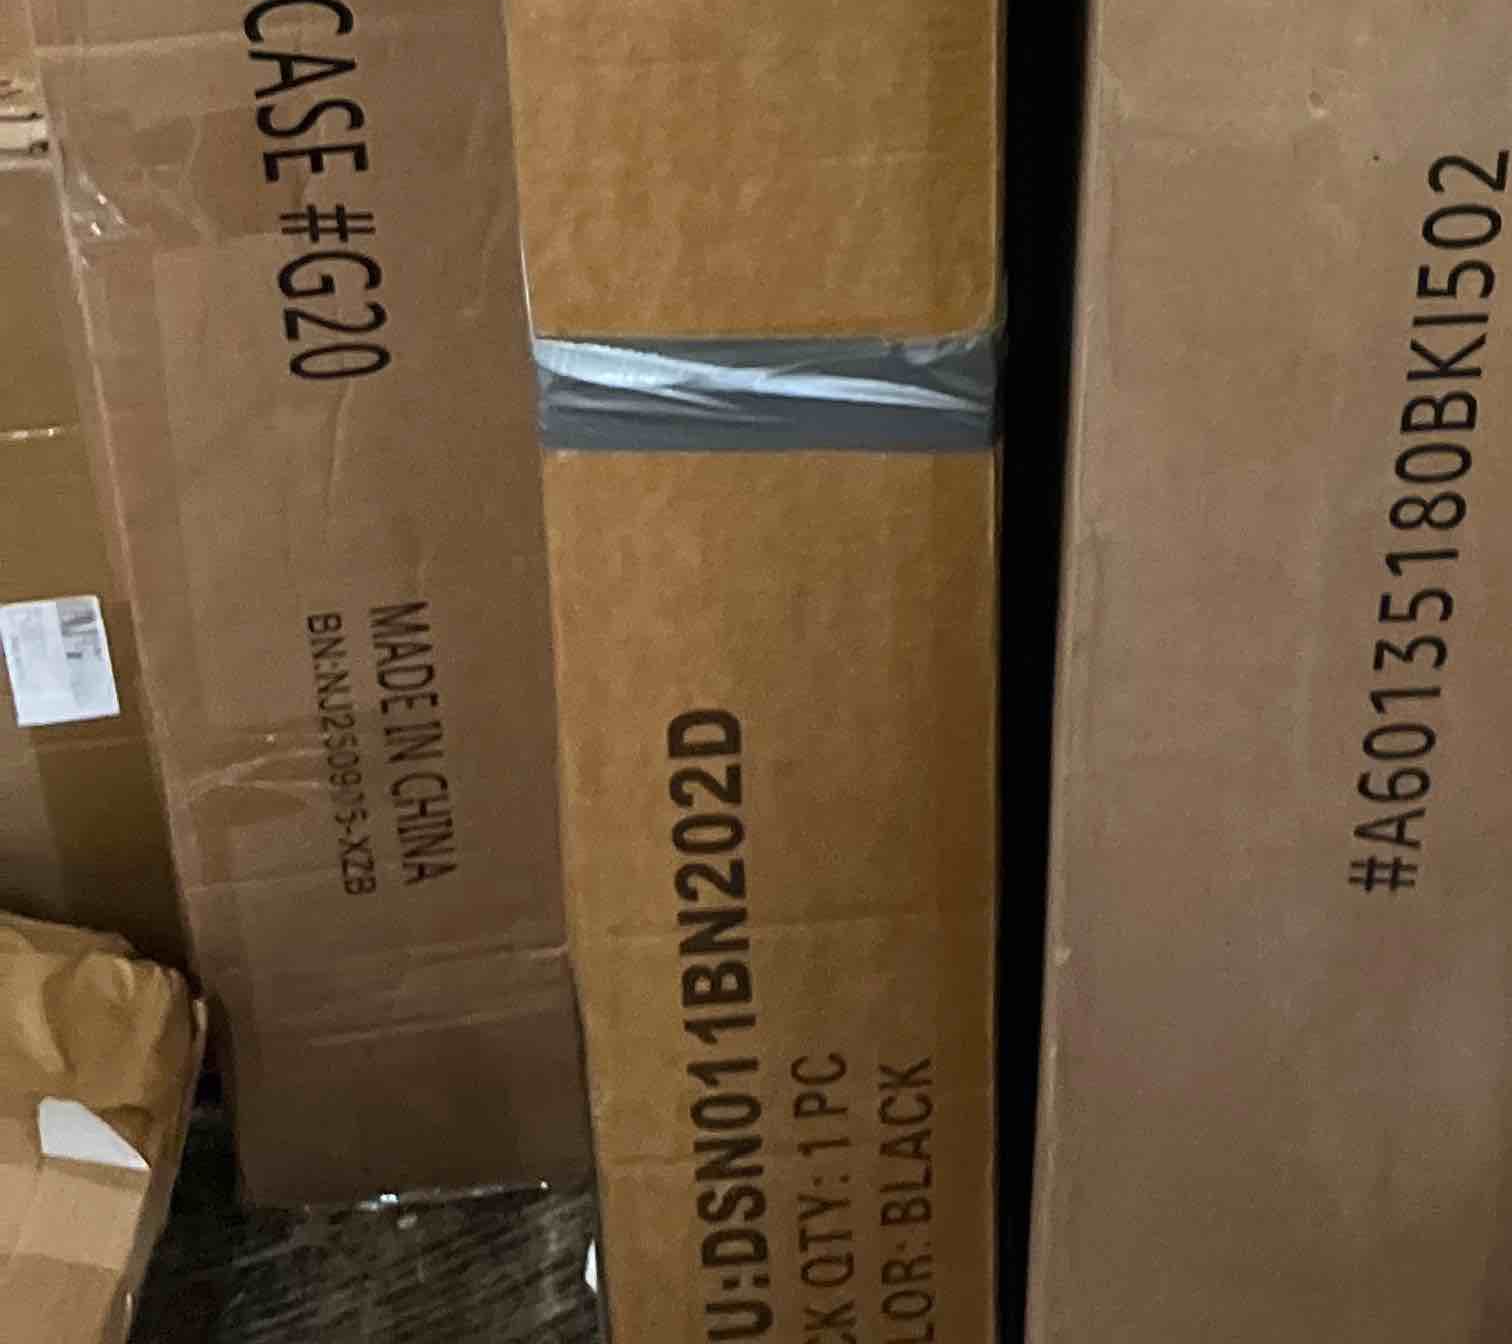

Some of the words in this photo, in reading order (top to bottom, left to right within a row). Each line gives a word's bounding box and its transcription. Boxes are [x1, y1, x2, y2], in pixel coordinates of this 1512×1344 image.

[277, 203, 391, 380] #G20
[370, 601, 439, 715] MADE
[384, 720, 444, 763] IN
[391, 771, 457, 886] CHINA
[791, 1051, 849, 1120] PC
[878, 1056, 933, 1227] BLACK
[799, 1135, 853, 1158] 1
[797, 1174, 854, 1288] QTY:
